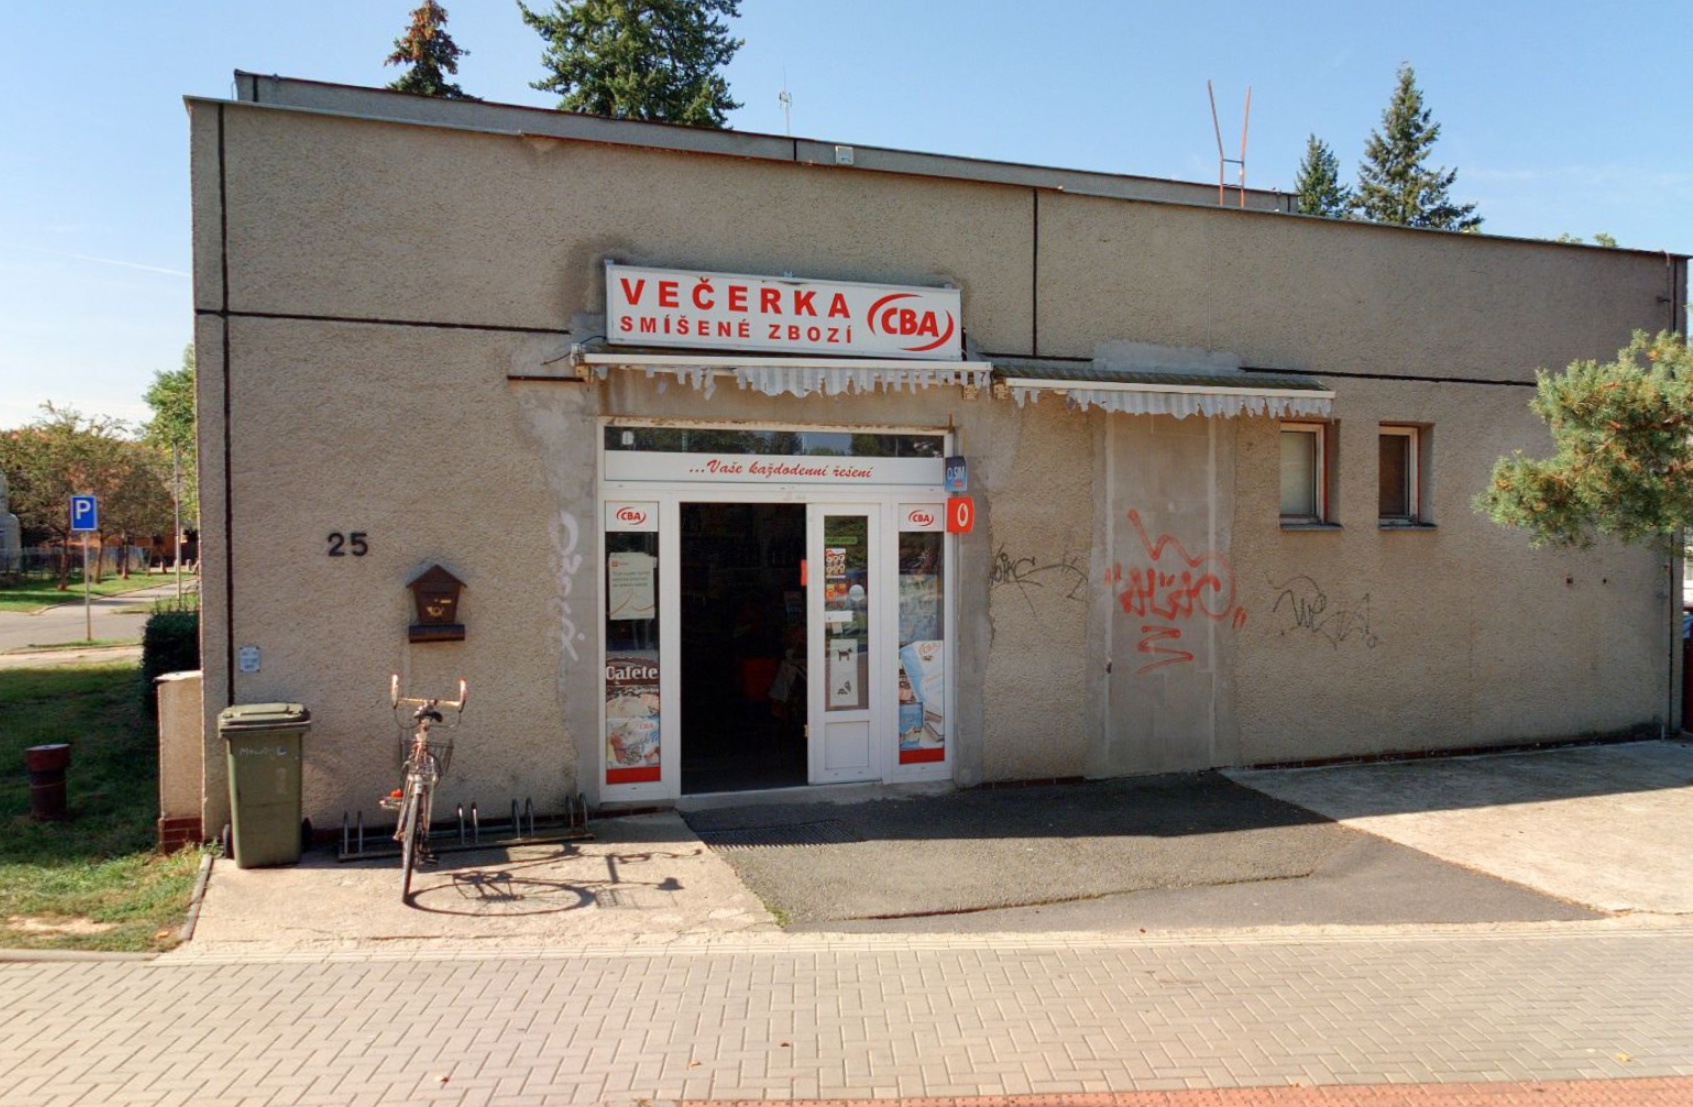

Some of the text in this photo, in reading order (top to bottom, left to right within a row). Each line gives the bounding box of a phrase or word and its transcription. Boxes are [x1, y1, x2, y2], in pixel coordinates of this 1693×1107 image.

[620, 276, 851, 319] VEČERKA
[620, 315, 852, 344] SMÍŠENÉ ZBOZÍ
[880, 306, 940, 339] CBA
[748, 461, 829, 479] každodenní
[832, 465, 874, 479] řešení
[75, 499, 92, 520] P
[620, 510, 641, 522] CBA
[912, 513, 930, 524] CBA
[327, 532, 369, 557] 25
[606, 665, 658, 680] Cafete
